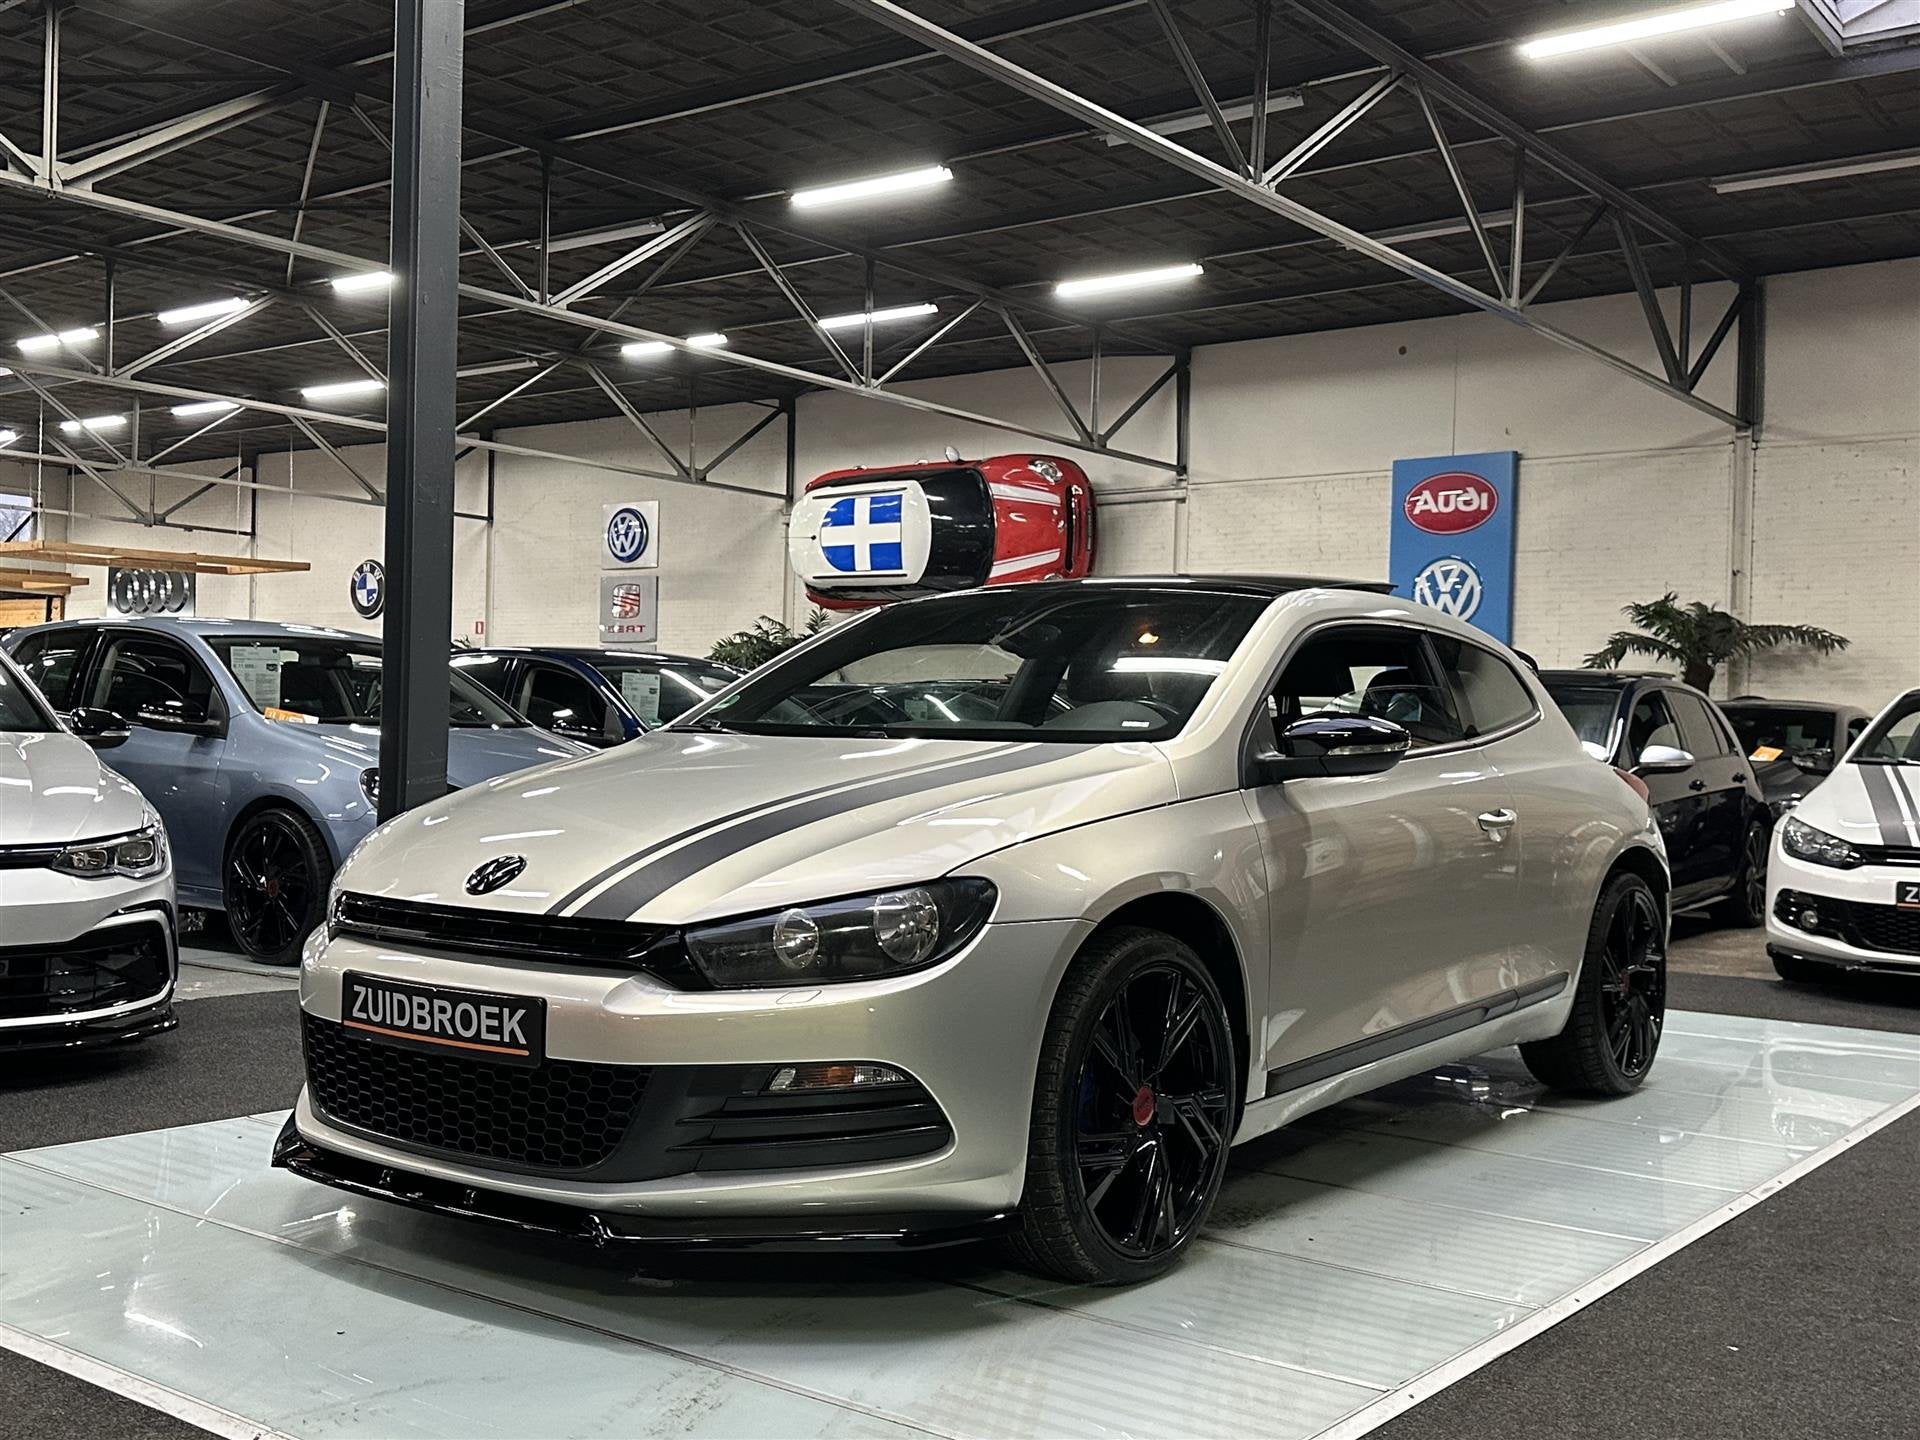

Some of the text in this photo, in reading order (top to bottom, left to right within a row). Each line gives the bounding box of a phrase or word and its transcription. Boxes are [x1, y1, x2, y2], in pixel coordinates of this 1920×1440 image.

[352, 563, 383, 581] BMW
[607, 624, 645, 634] SEAT
[1905, 886, 1920, 902] Z
[352, 985, 527, 1044] ZUIDBROEK
